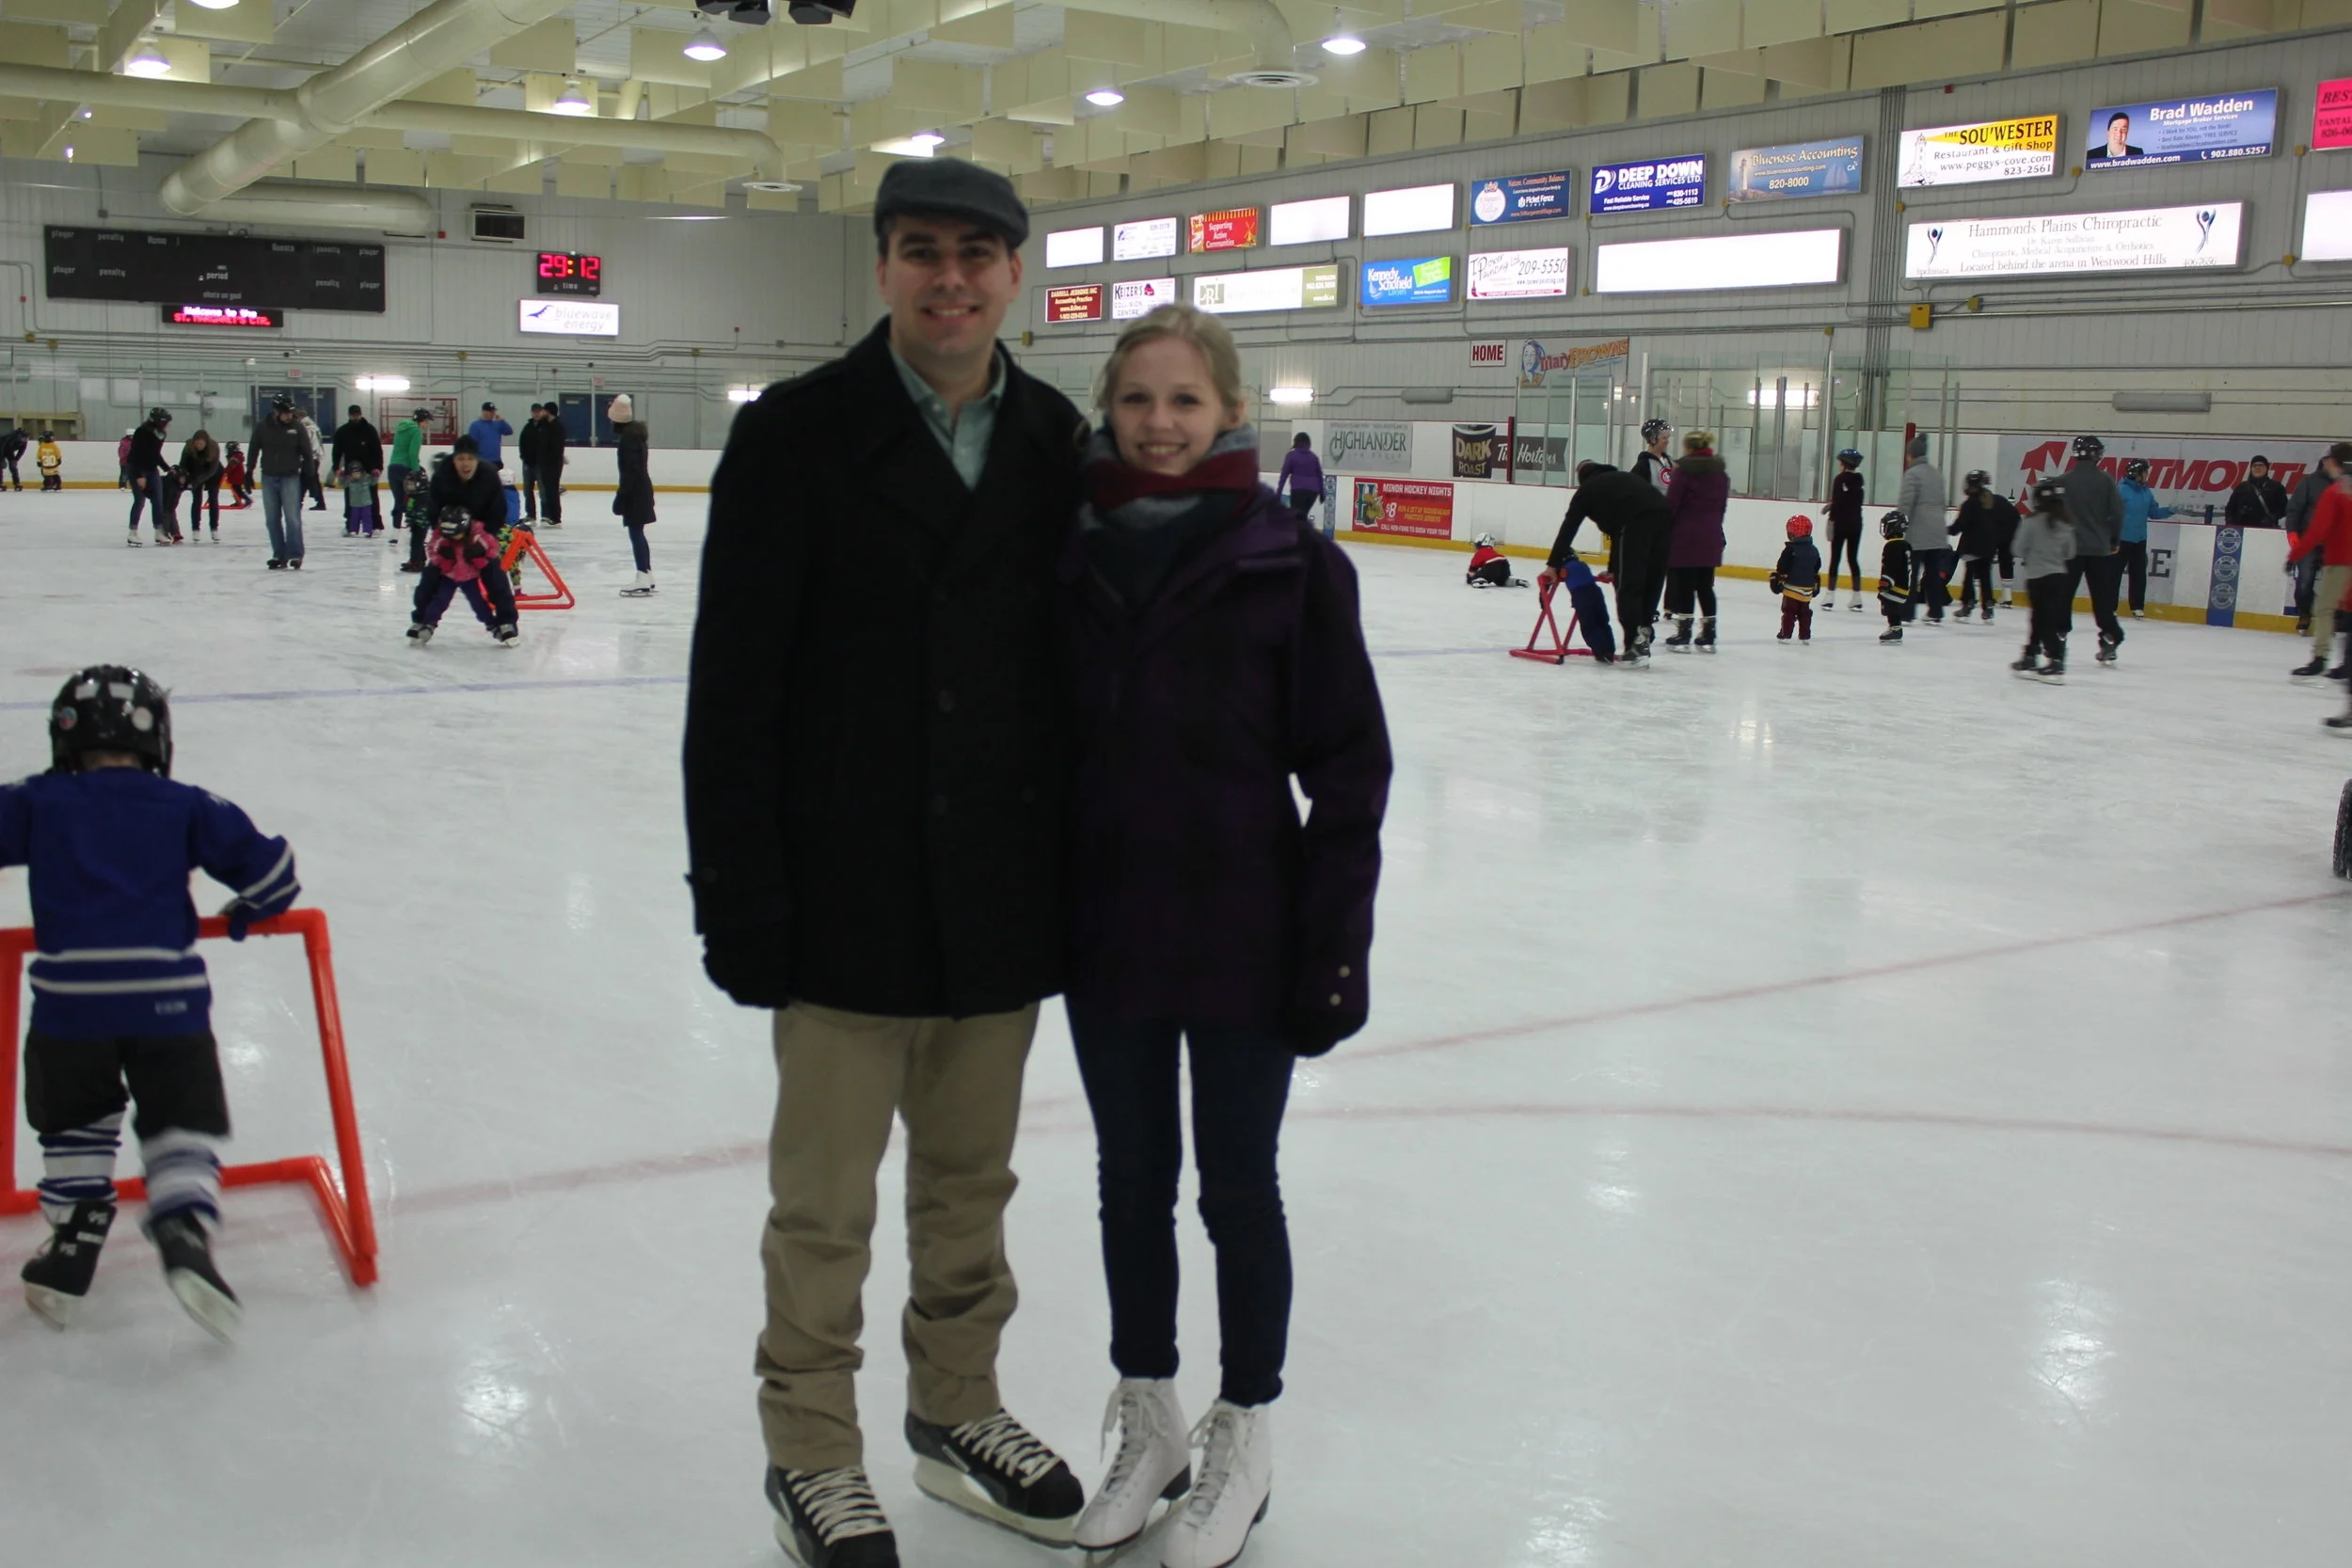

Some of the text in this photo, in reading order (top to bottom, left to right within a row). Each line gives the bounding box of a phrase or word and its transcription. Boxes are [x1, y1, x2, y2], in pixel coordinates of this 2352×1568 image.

[2322, 90, 2352, 104] BES
[2150, 98, 2253, 121] Brad Wadden
[2163, 113, 2239, 127] Mortgage Broker Services
[1960, 119, 2053, 145] SOU'WESTER
[1751, 146, 1858, 166] Bluenose Accounting
[1934, 147, 1989, 160] Restaurant
[2004, 142, 2022, 153] Gift
[2026, 140, 2053, 151] Shop
[2210, 147, 2266, 159] 902.880.5257
[1940, 154, 2051, 172] www.peggys-cove.com
[2090, 154, 2181, 169] www.bradwadden.com
[1618, 160, 1703, 183] DEEP DOWN
[2004, 164, 2051, 176] 823-2561
[1618, 175, 1702, 190] CLEANING SERVICES LTD.
[1769, 176, 1809, 189] 820-8000
[1209, 220, 1232, 231] Supporting
[1969, 215, 2162, 238] Hammonds Plains Chiropractic
[1214, 230, 1228, 240] Active
[1206, 239, 1235, 248] Communities
[539, 254, 601, 279] 29:12
[1518, 259, 1567, 276] 209-5550
[1961, 253, 2167, 272] Located behind the arena in Westwood Hills
[1368, 267, 1399, 281] Kennedy
[1378, 275, 1413, 291] Schofield
[1114, 284, 1144, 300] KEIZER'S
[224, 308, 237, 318] to
[556, 306, 612, 321] bluewave
[564, 319, 606, 332] energy
[1472, 344, 1503, 361] HOME
[1334, 431, 1406, 451] HIGHLANDER
[1455, 436, 1492, 462] DARK
[1497, 443, 1509, 462] Ti
[1458, 461, 1486, 476] ROAST
[1383, 483, 1453, 497] MINOR HOCKEY NIGHTS
[1386, 502, 1397, 518] $8
